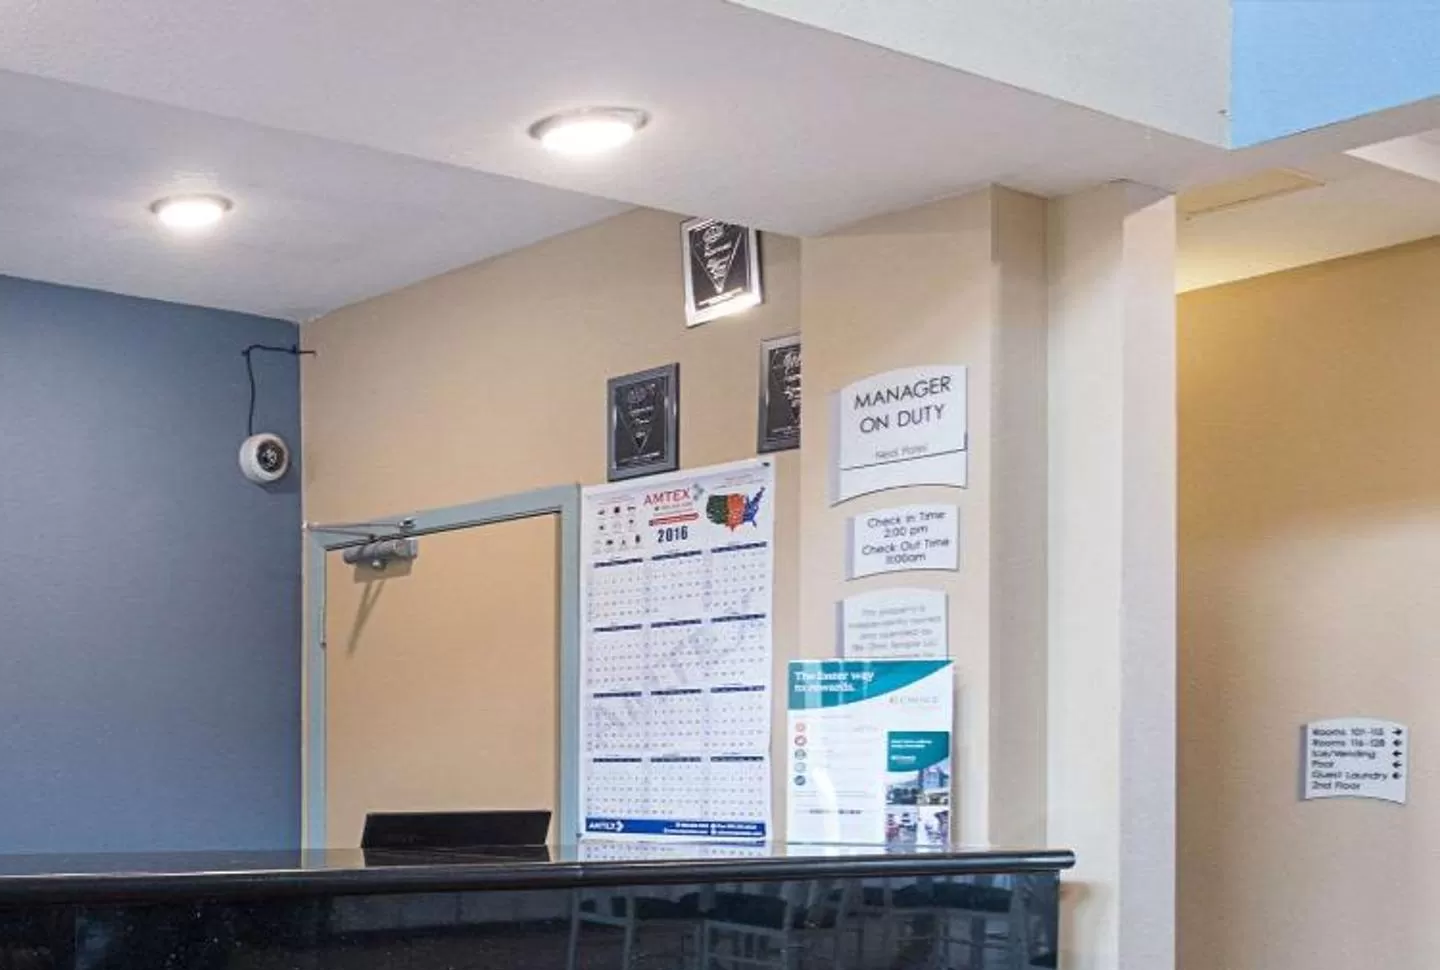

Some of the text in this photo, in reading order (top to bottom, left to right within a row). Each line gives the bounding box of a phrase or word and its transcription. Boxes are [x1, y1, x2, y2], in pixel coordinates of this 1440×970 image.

[854, 375, 951, 410] MANAGER
[859, 403, 945, 433] ON DUTY
[644, 488, 691, 505] AMTEX
[867, 516, 901, 528] Check
[919, 511, 947, 521] Time
[657, 525, 688, 543] 2016
[861, 538, 949, 556] Check Out Time
[1312, 728, 1346, 736] Rooms
[1312, 739, 1346, 747] Rooms
[1345, 771, 1388, 781] Laundry
[1311, 781, 1361, 790] 2nd Floor
